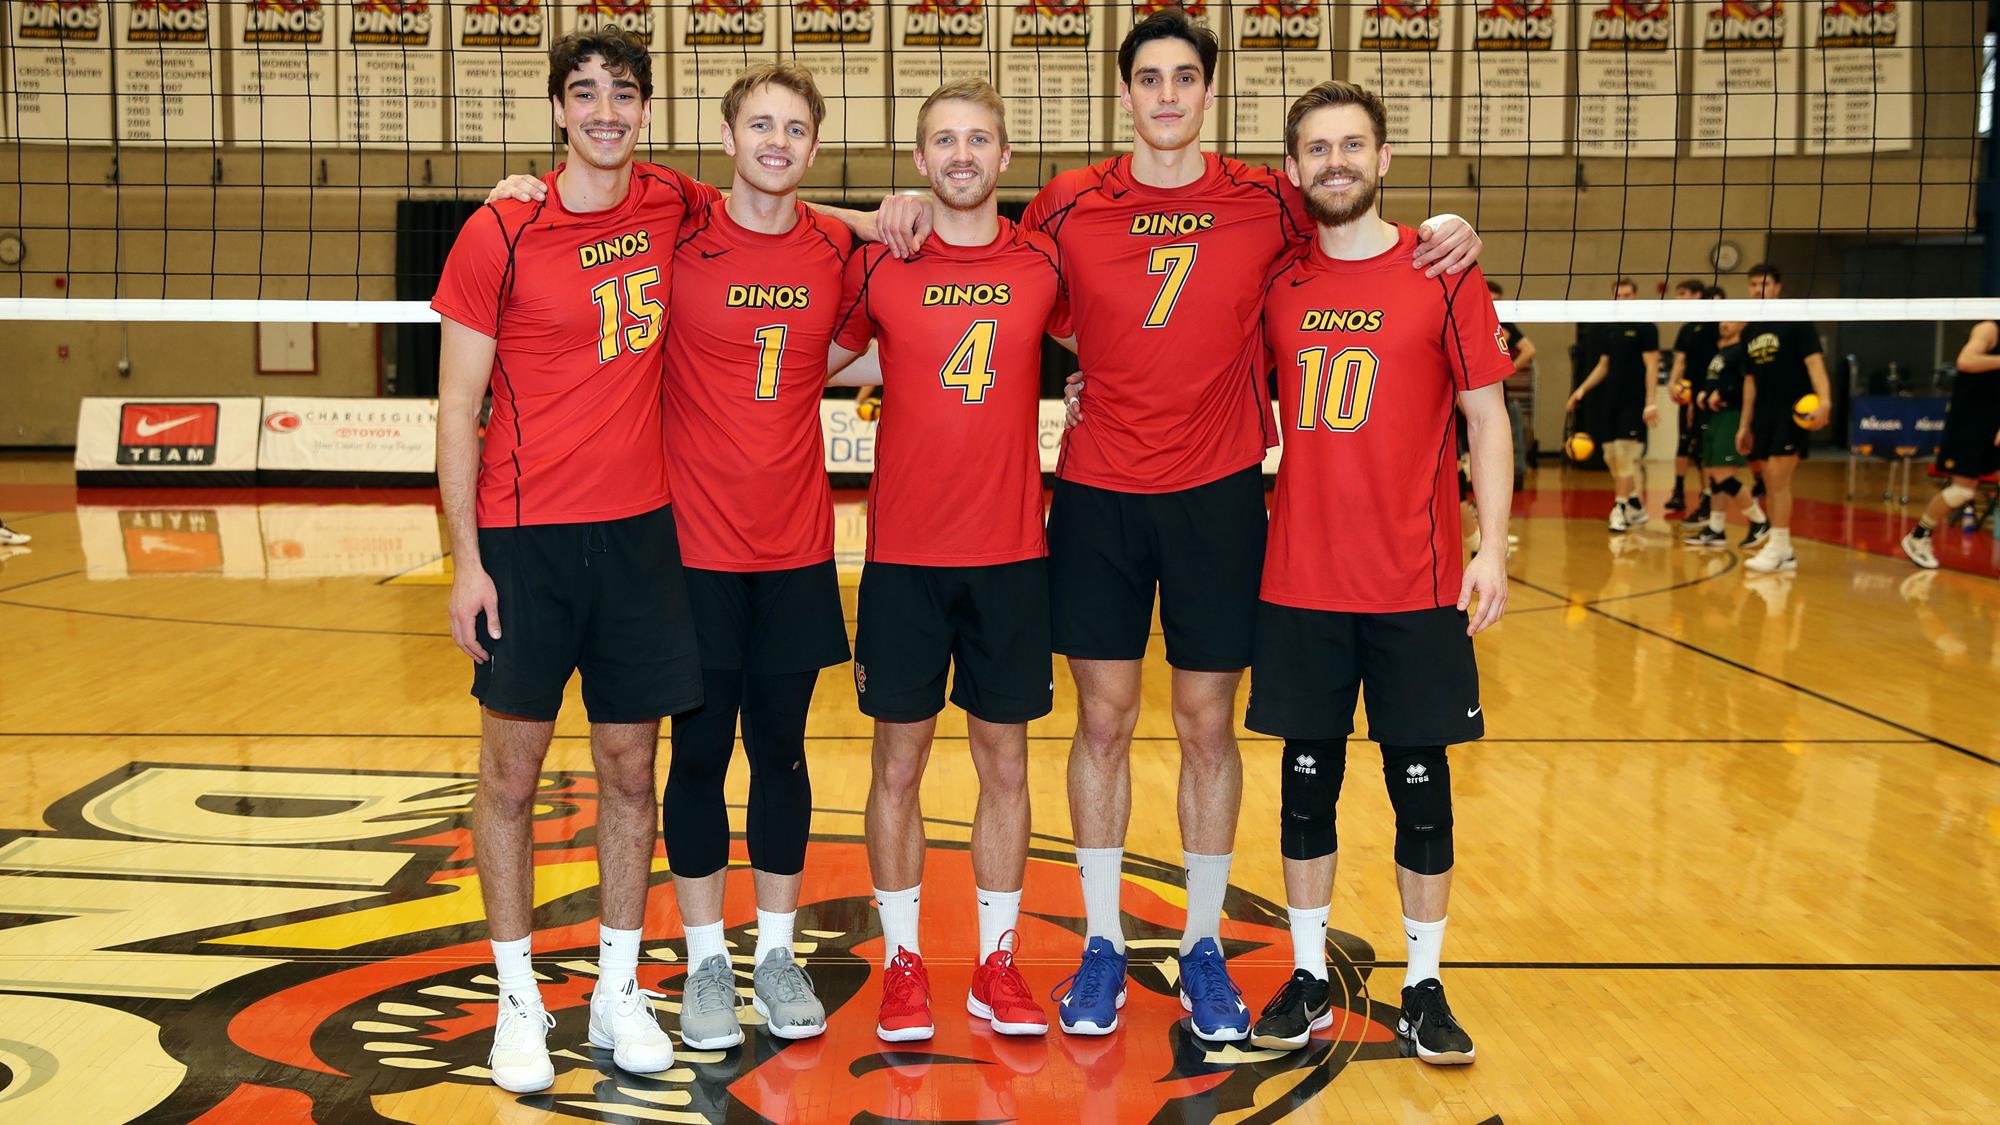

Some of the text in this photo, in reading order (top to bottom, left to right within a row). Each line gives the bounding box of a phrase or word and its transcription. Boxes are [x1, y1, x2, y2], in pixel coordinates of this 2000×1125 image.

[22, 6, 99, 28] DINOS
[130, 8, 207, 30] DINOS
[246, 10, 323, 32] DINOS
[355, 12, 431, 33] DINOS
[464, 13, 541, 35] DINOS
[688, 13, 765, 34] DINOS
[794, 10, 872, 32] DINOS
[907, 13, 984, 35] DINOS
[1014, 14, 1090, 35] DINOS
[1243, 15, 1321, 37] DINOS
[1363, 17, 1440, 38] DINOS
[1819, 14, 1896, 36] DINOS
[1478, 18, 1554, 39] DINOS
[1592, 19, 1668, 40] DINOS
[1706, 18, 1784, 39] DINOS
[45, 57, 76, 65] MEN'S
[145, 59, 194, 68] WOMEN'S
[261, 59, 309, 68] WOMEN'S
[367, 61, 415, 71] FOOTBALL
[251, 71, 320, 80] FIELD HOCKEY
[466, 69, 540, 78] MEN'S HOCKEY
[1129, 212, 1216, 237] DINOS
[578, 230, 650, 270] DINOS
[922, 282, 1011, 307] DINOS
[1142, 242, 1199, 329] 7
[726, 284, 810, 310] DINOS
[591, 265, 665, 364] 15
[1300, 308, 1385, 333] DINOS
[753, 323, 788, 401] 1
[938, 319, 998, 405] 4
[1297, 346, 1380, 432] 10
[350, 428, 401, 438] TOYOTA
[130, 448, 204, 462] TEAM
